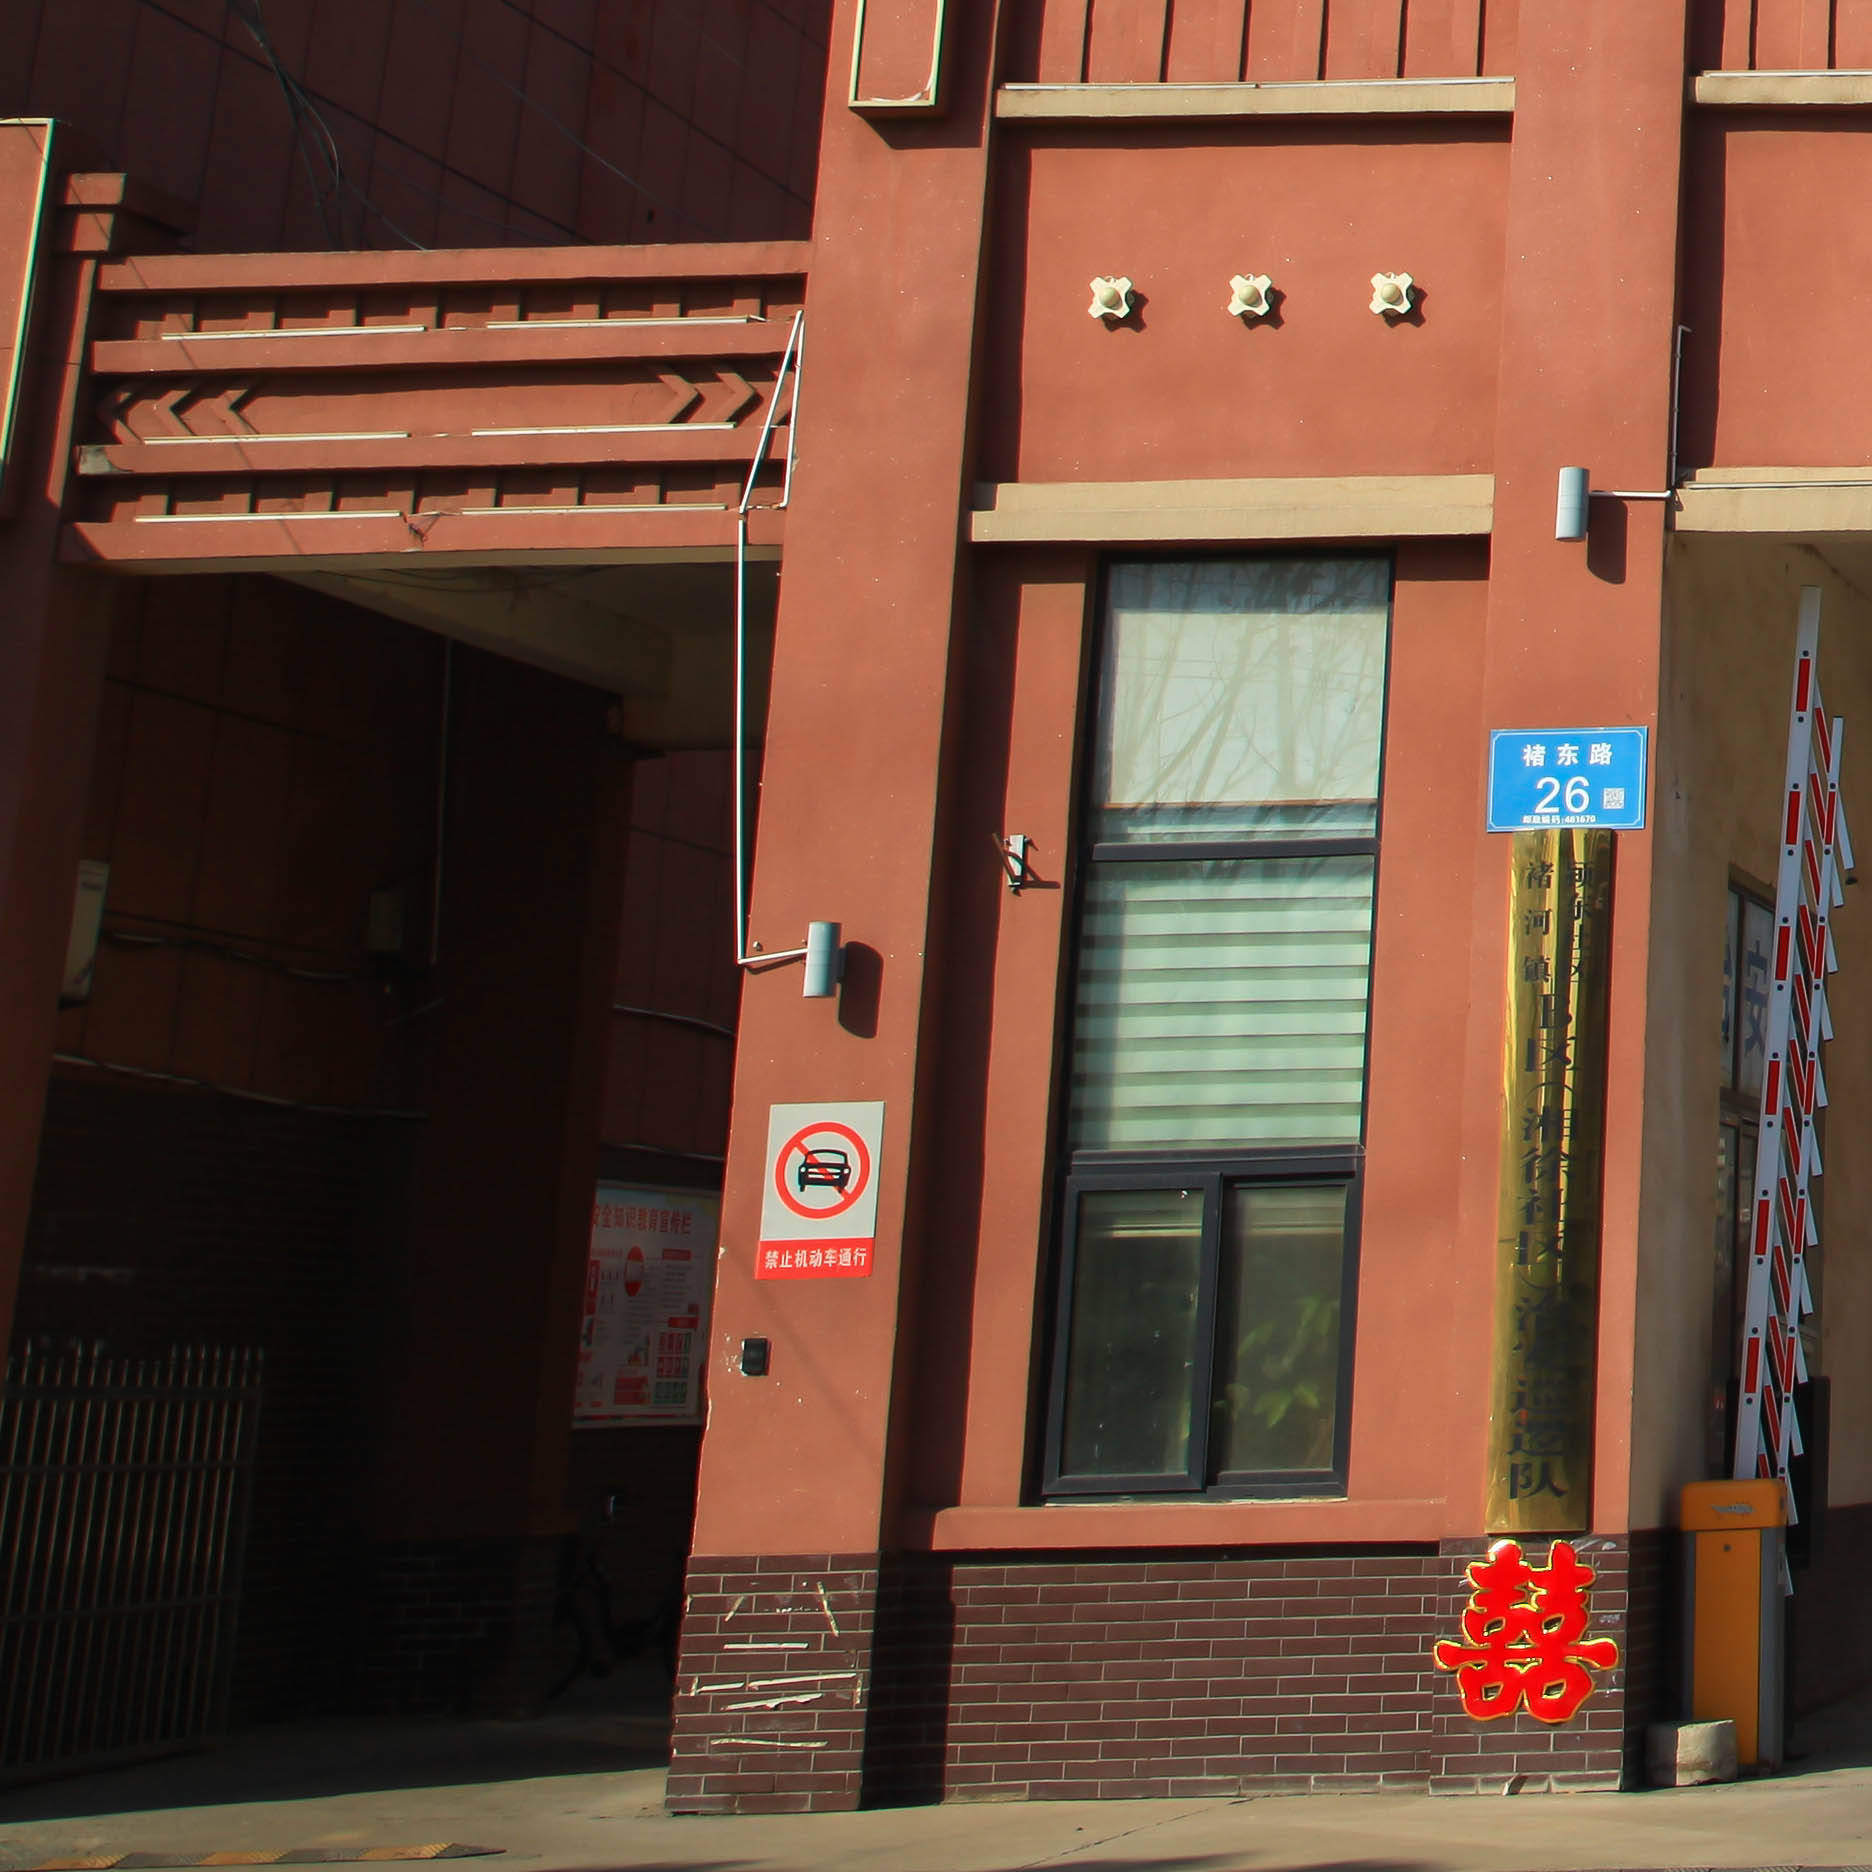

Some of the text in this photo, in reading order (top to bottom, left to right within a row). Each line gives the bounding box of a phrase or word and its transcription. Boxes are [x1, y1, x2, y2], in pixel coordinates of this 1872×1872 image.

[1522, 742, 1614, 767] 褚东路
[1534, 776, 1590, 814] 26
[765, 1247, 867, 1270] 禁止机动车通行
